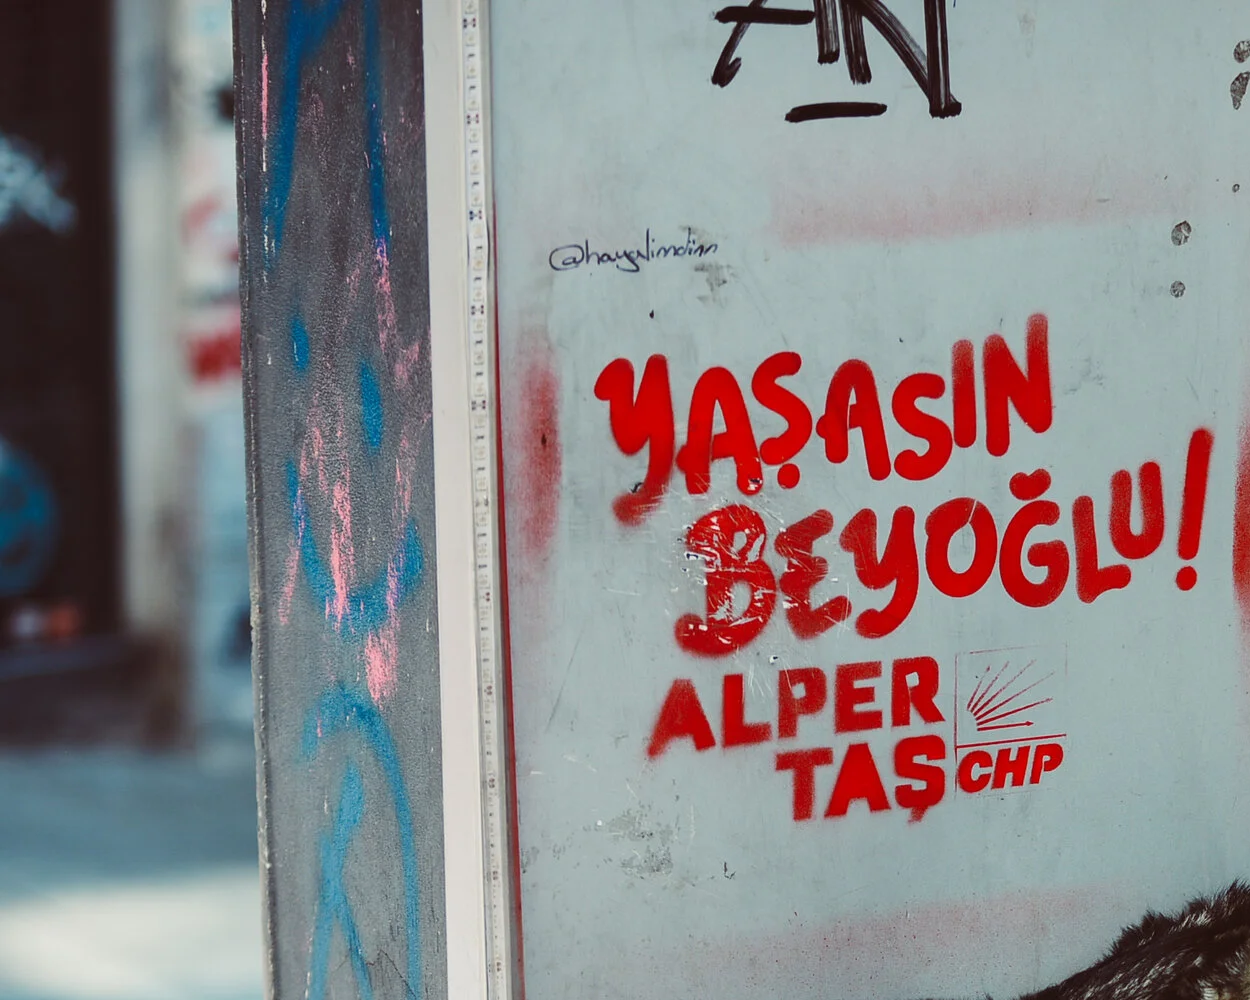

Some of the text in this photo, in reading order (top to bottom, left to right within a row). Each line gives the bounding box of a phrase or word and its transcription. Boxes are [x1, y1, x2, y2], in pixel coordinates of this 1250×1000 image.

[593, 312, 1054, 526] YAŞASIN
[674, 427, 1214, 658] BEYOĞLU!
[646, 655, 946, 760] ALPER
[775, 733, 946, 824] TAŞ
[956, 743, 1065, 794] CHP
